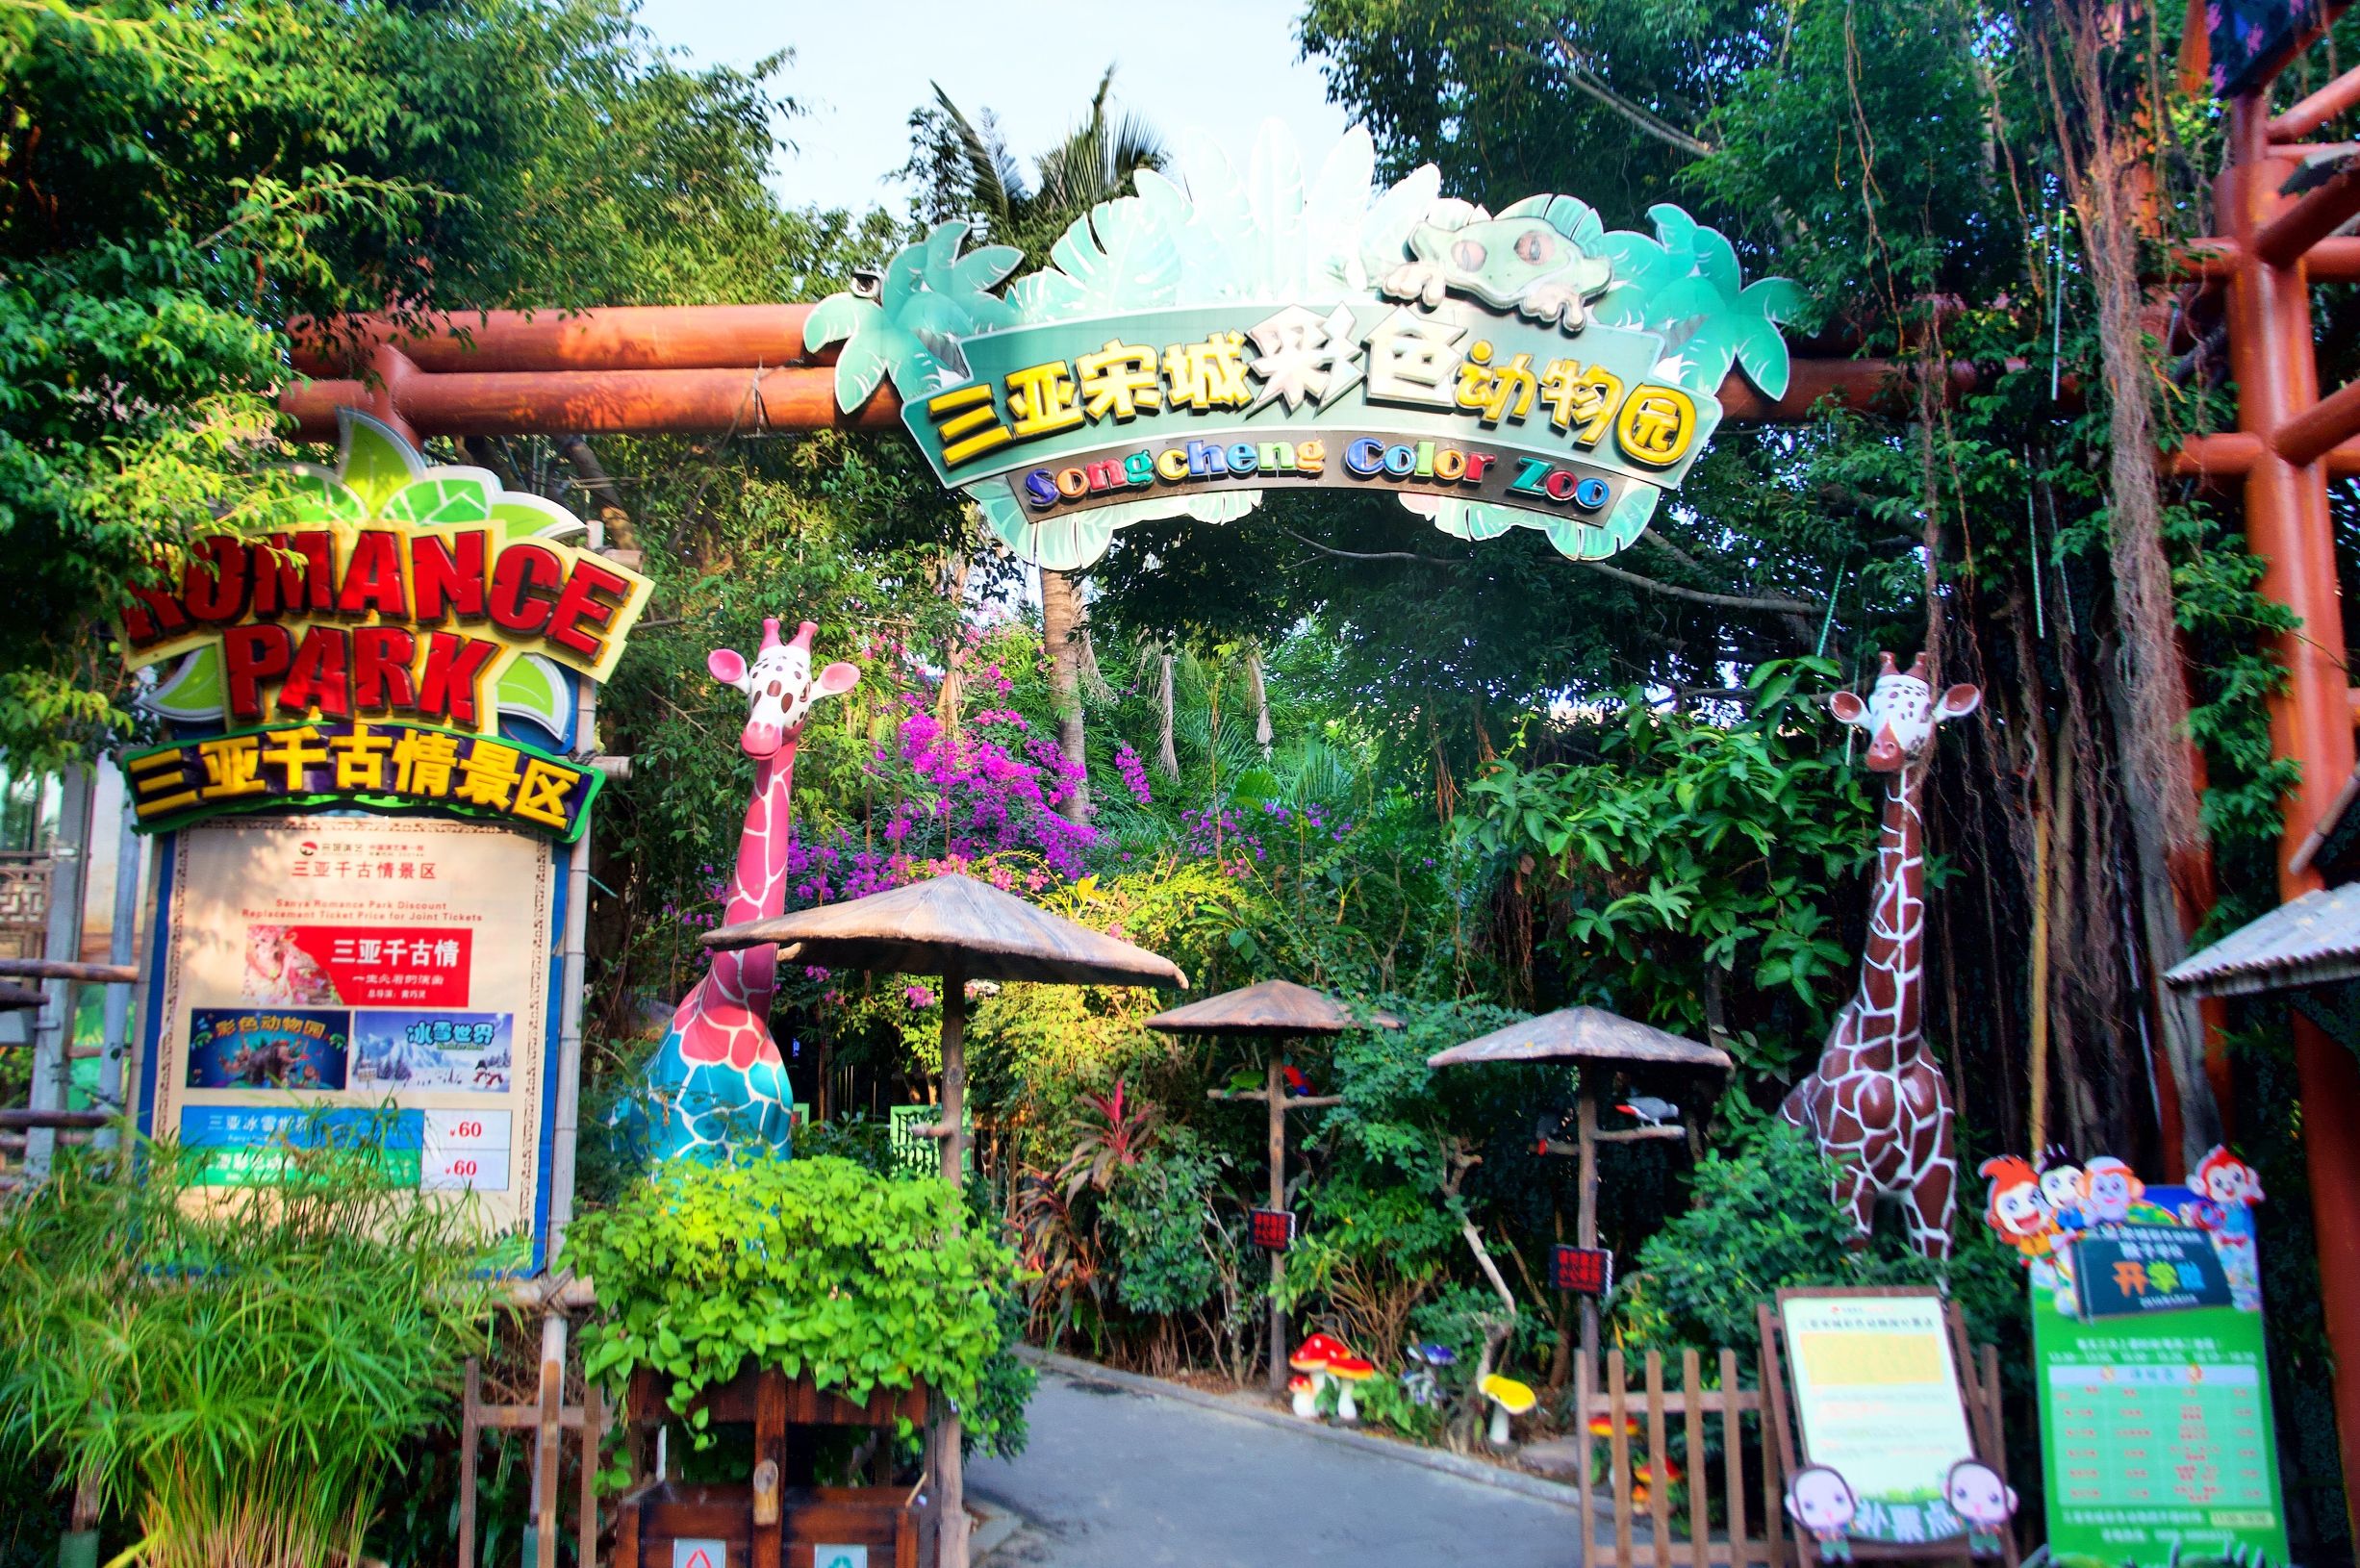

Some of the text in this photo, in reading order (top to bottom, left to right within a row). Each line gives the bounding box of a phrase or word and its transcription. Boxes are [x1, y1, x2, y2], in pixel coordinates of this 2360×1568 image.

[928, 302, 1696, 468] 三亚宋城彩色动物园
[1024, 437, 1611, 510] Songcheng Color Zoo
[222, 622, 500, 728] PARK
[129, 724, 582, 830] 三亚千古情景区
[292, 861, 437, 879] 三亚千古情景区
[241, 909, 315, 920] Replacement
[358, 911, 385, 920] Price
[443, 912, 483, 922] Tickets
[315, 899, 364, 908] Romance
[369, 900, 393, 909] Park
[397, 901, 446, 910] Discount
[331, 939, 460, 968] 三亚千古情
[215, 1016, 327, 1039] 彩色动物园
[405, 1020, 496, 1045] 冰雪世界
